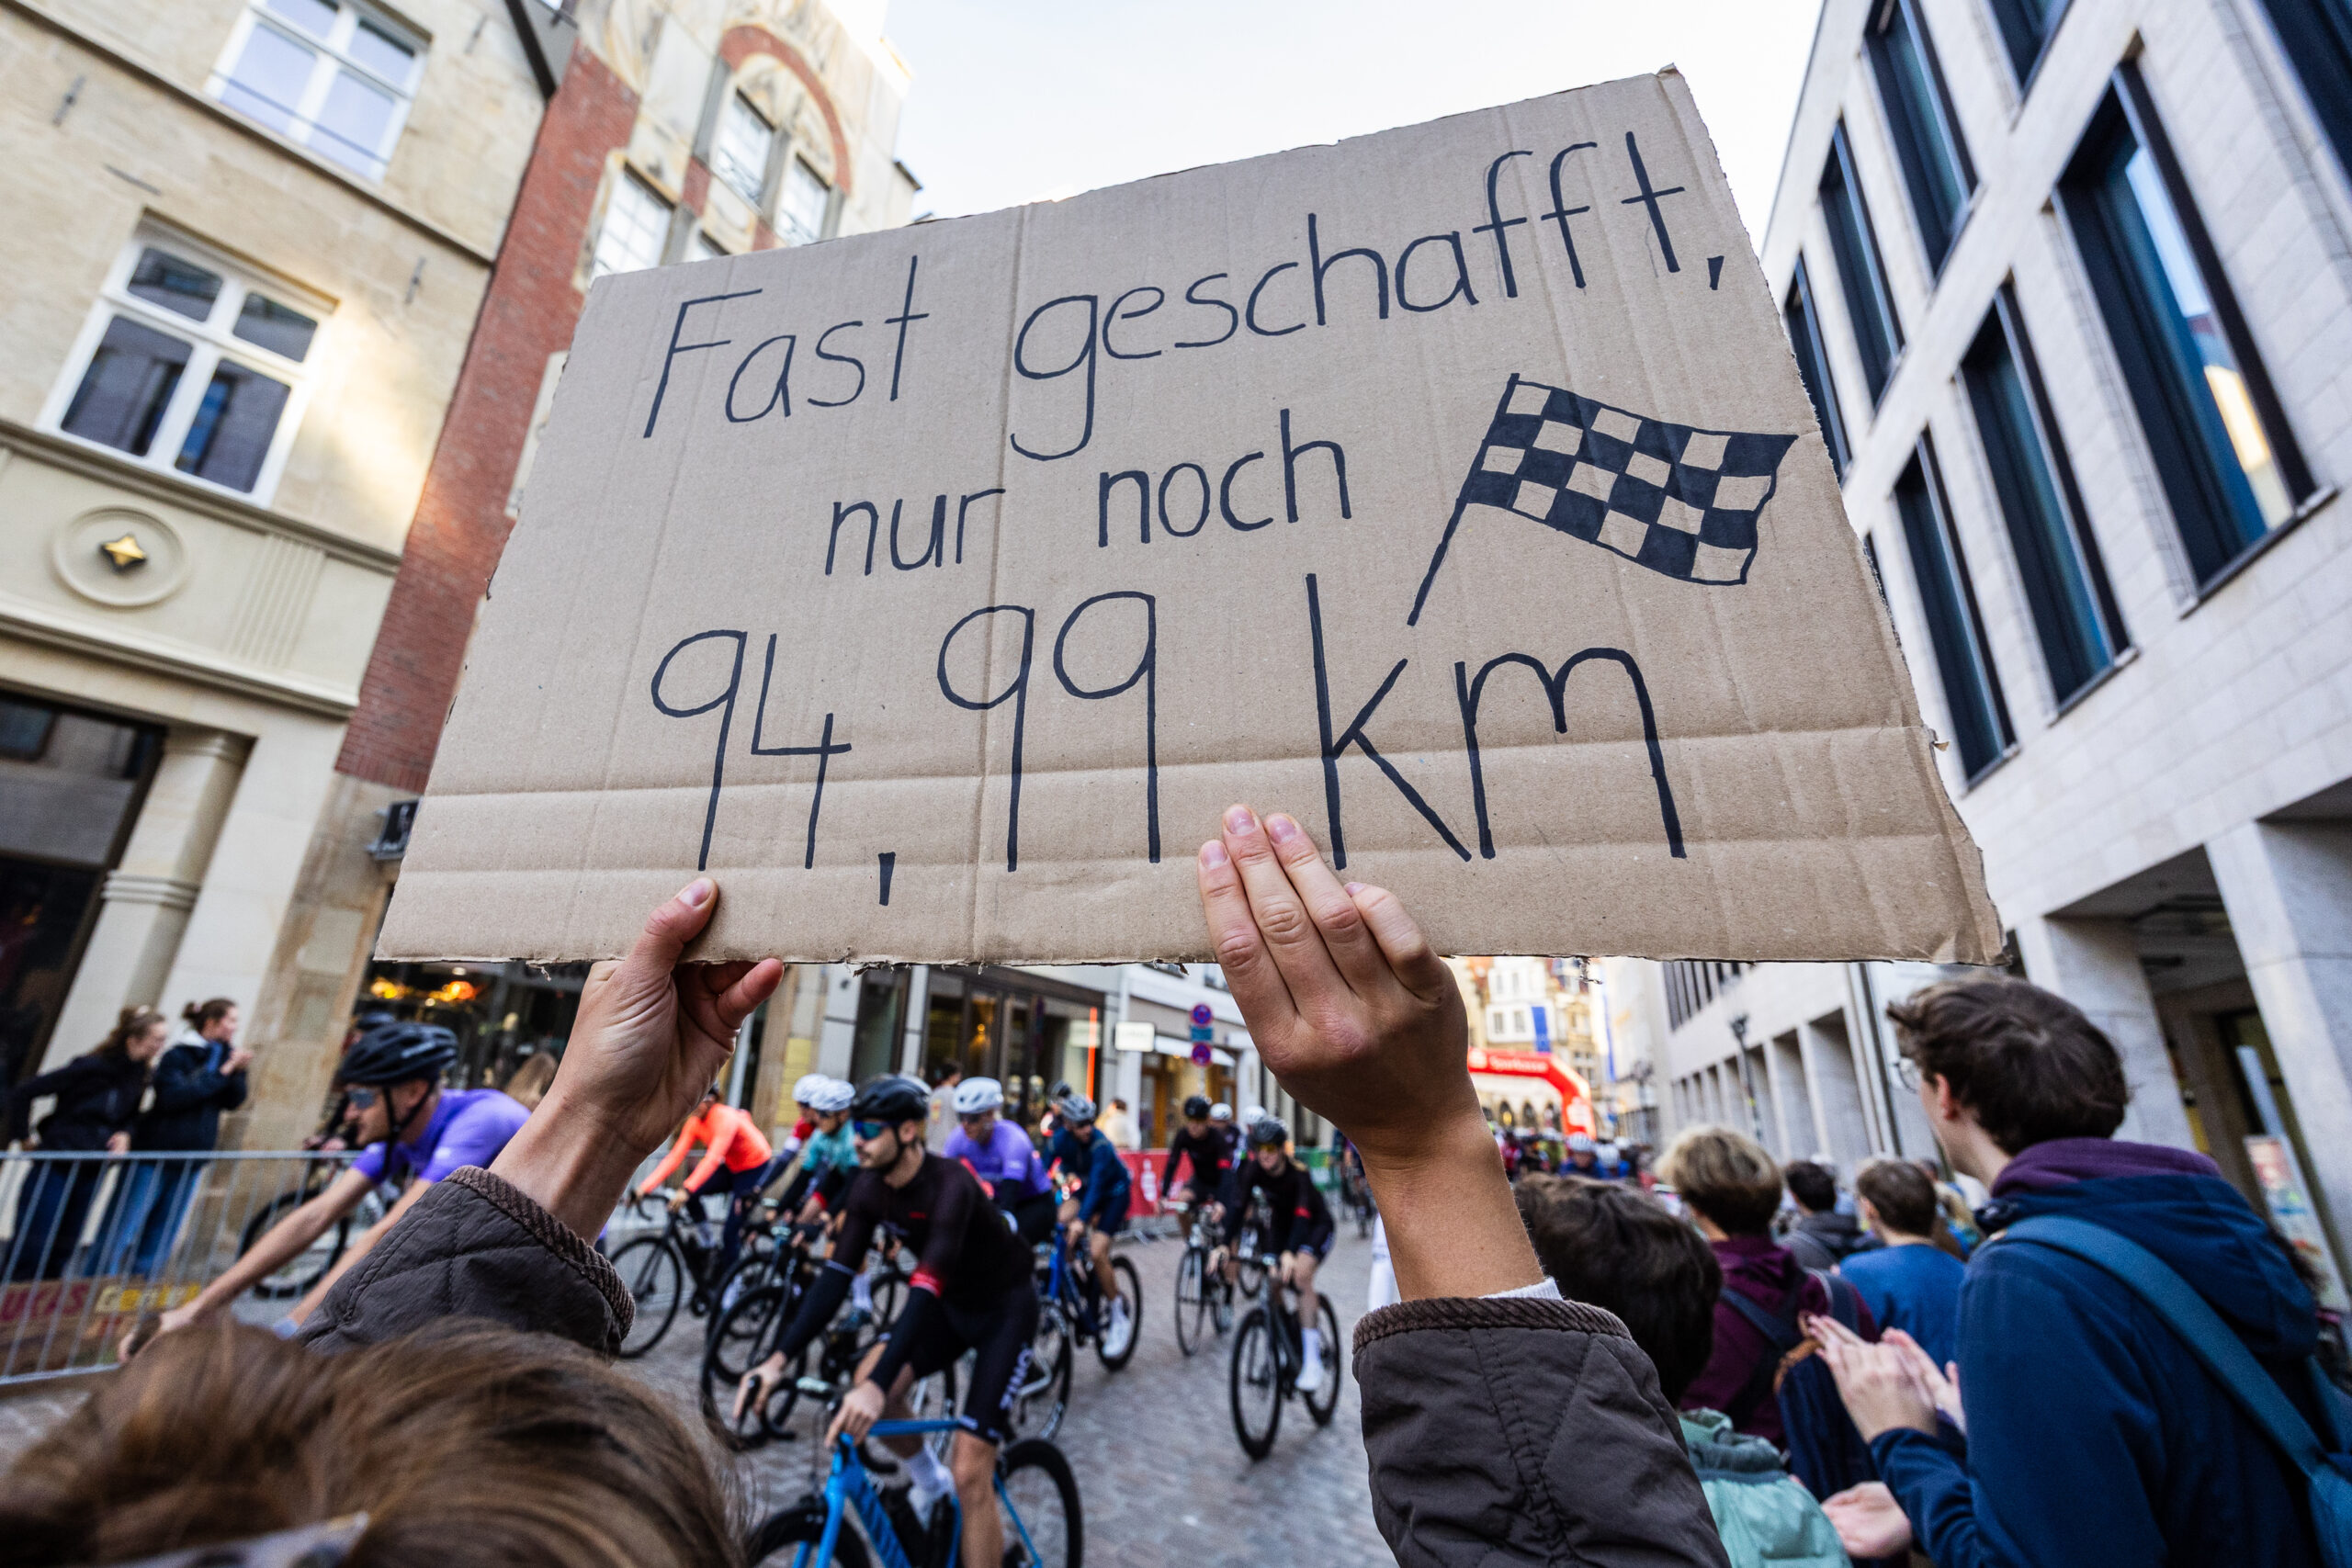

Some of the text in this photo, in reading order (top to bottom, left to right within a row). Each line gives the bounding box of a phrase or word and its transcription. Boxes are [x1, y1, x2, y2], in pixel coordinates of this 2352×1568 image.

[642, 130, 1725, 463] Fast geschafft,
[824, 407, 1353, 577] nur noch
[650, 571, 1689, 908] 94,99 km
